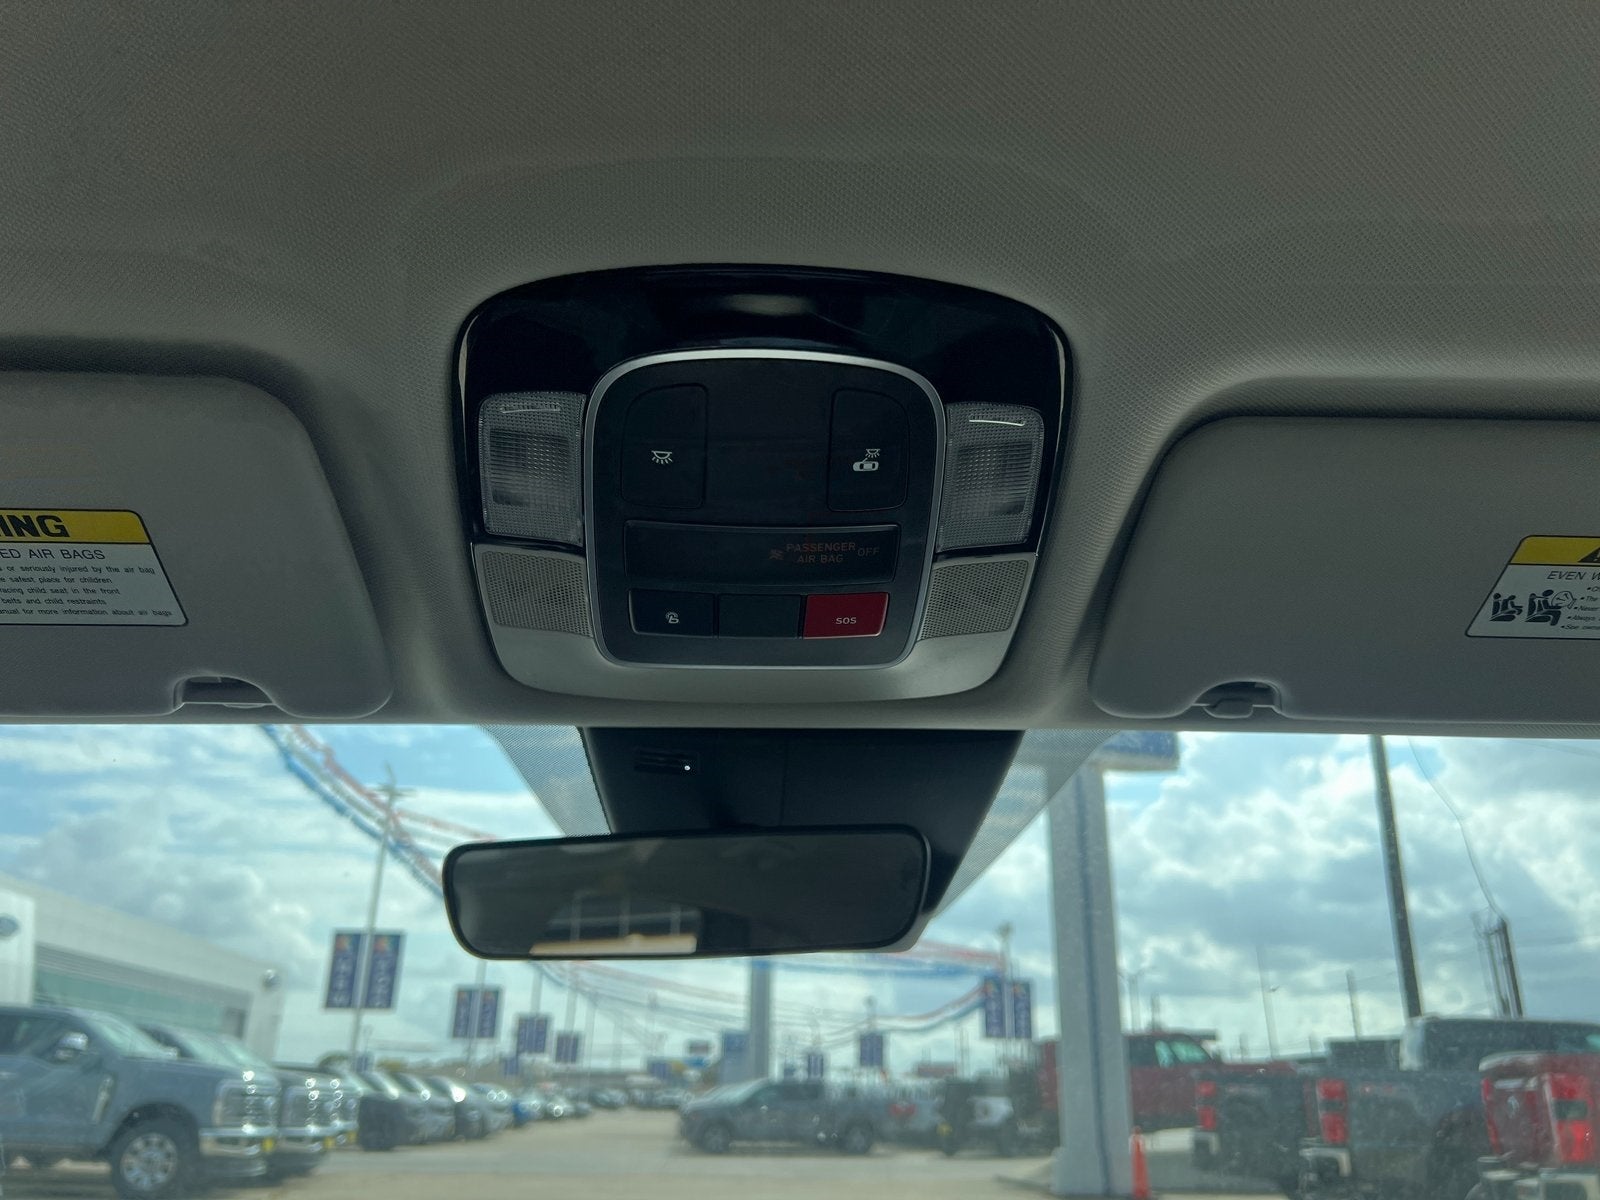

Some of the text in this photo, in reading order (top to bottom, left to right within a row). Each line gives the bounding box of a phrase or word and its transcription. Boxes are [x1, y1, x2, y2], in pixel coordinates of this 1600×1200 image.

[786, 543, 856, 552] PASSENGER
[857, 547, 880, 556] OFF
[29, 549, 55, 559] AIR
[60, 549, 105, 560] BAGS
[797, 555, 843, 563] AIR BAG
[20, 565, 55, 573] seriously
[59, 565, 89, 574] injured
[91, 566, 102, 574] by
[138, 566, 155, 575] bag
[1547, 571, 1587, 580] EVEN
[9, 576, 34, 584] safest
[38, 576, 60, 584] place
[79, 576, 112, 584] children
[49, 587, 67, 595] seat
[100, 587, 120, 595] front
[67, 597, 107, 605] restraints
[62, 608, 107, 616] information
[111, 608, 134, 616] about
[835, 617, 857, 625] SOS
